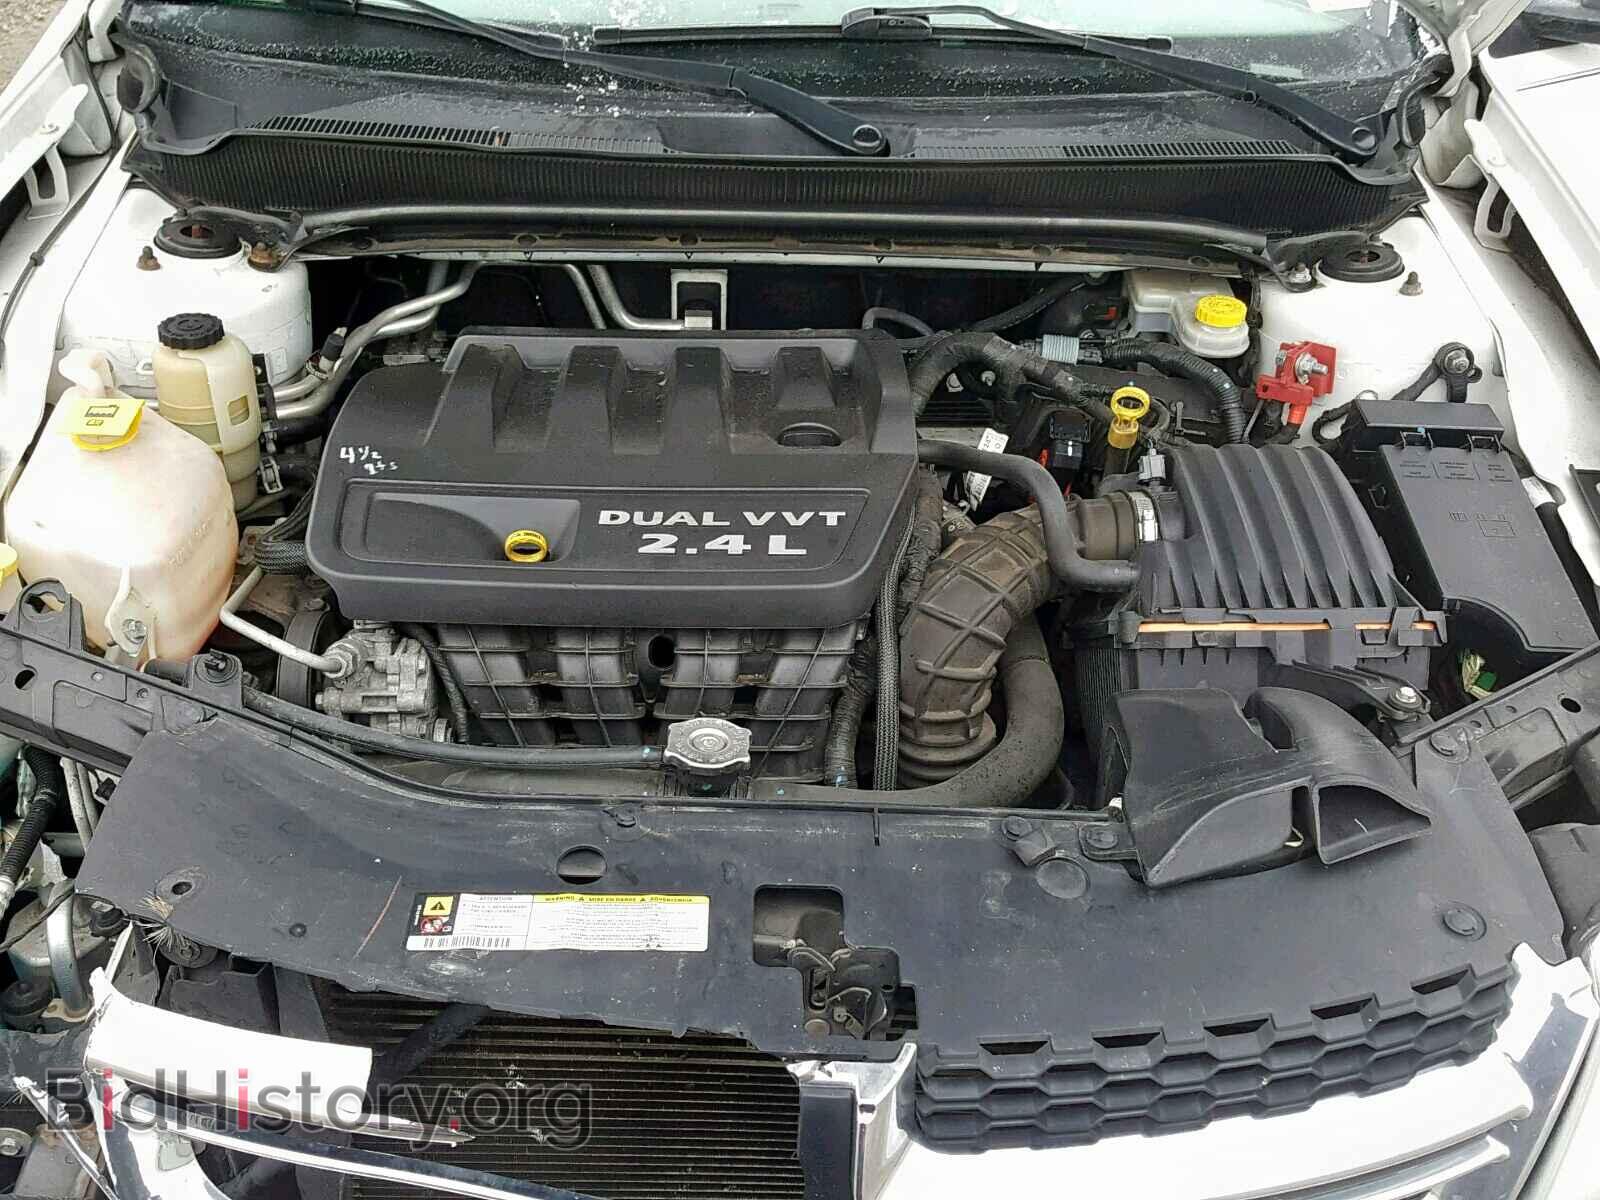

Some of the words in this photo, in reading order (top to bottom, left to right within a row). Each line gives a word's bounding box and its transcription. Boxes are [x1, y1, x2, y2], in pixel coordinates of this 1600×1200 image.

[340, 446, 355, 464] 4
[598, 510, 730, 526] DUAL
[742, 511, 846, 526] VVT
